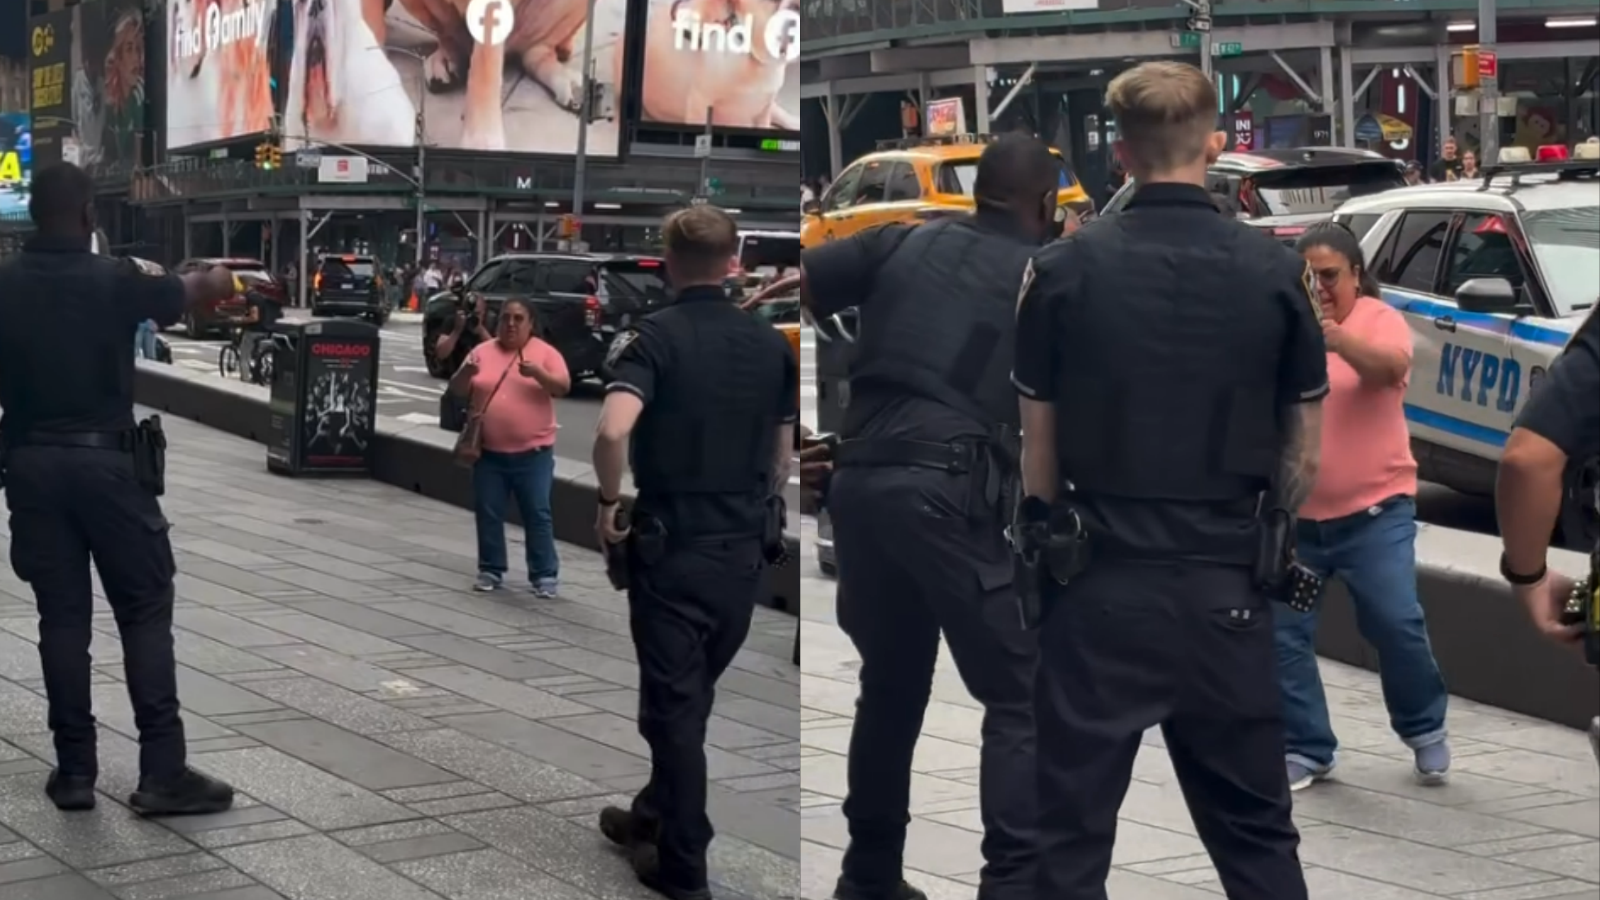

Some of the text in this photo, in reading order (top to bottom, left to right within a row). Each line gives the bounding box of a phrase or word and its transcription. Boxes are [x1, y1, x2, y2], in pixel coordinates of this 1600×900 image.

[671, 7, 753, 51] find
[312, 343, 370, 355] CHICAGO
[1436, 341, 1521, 413] NYPD
